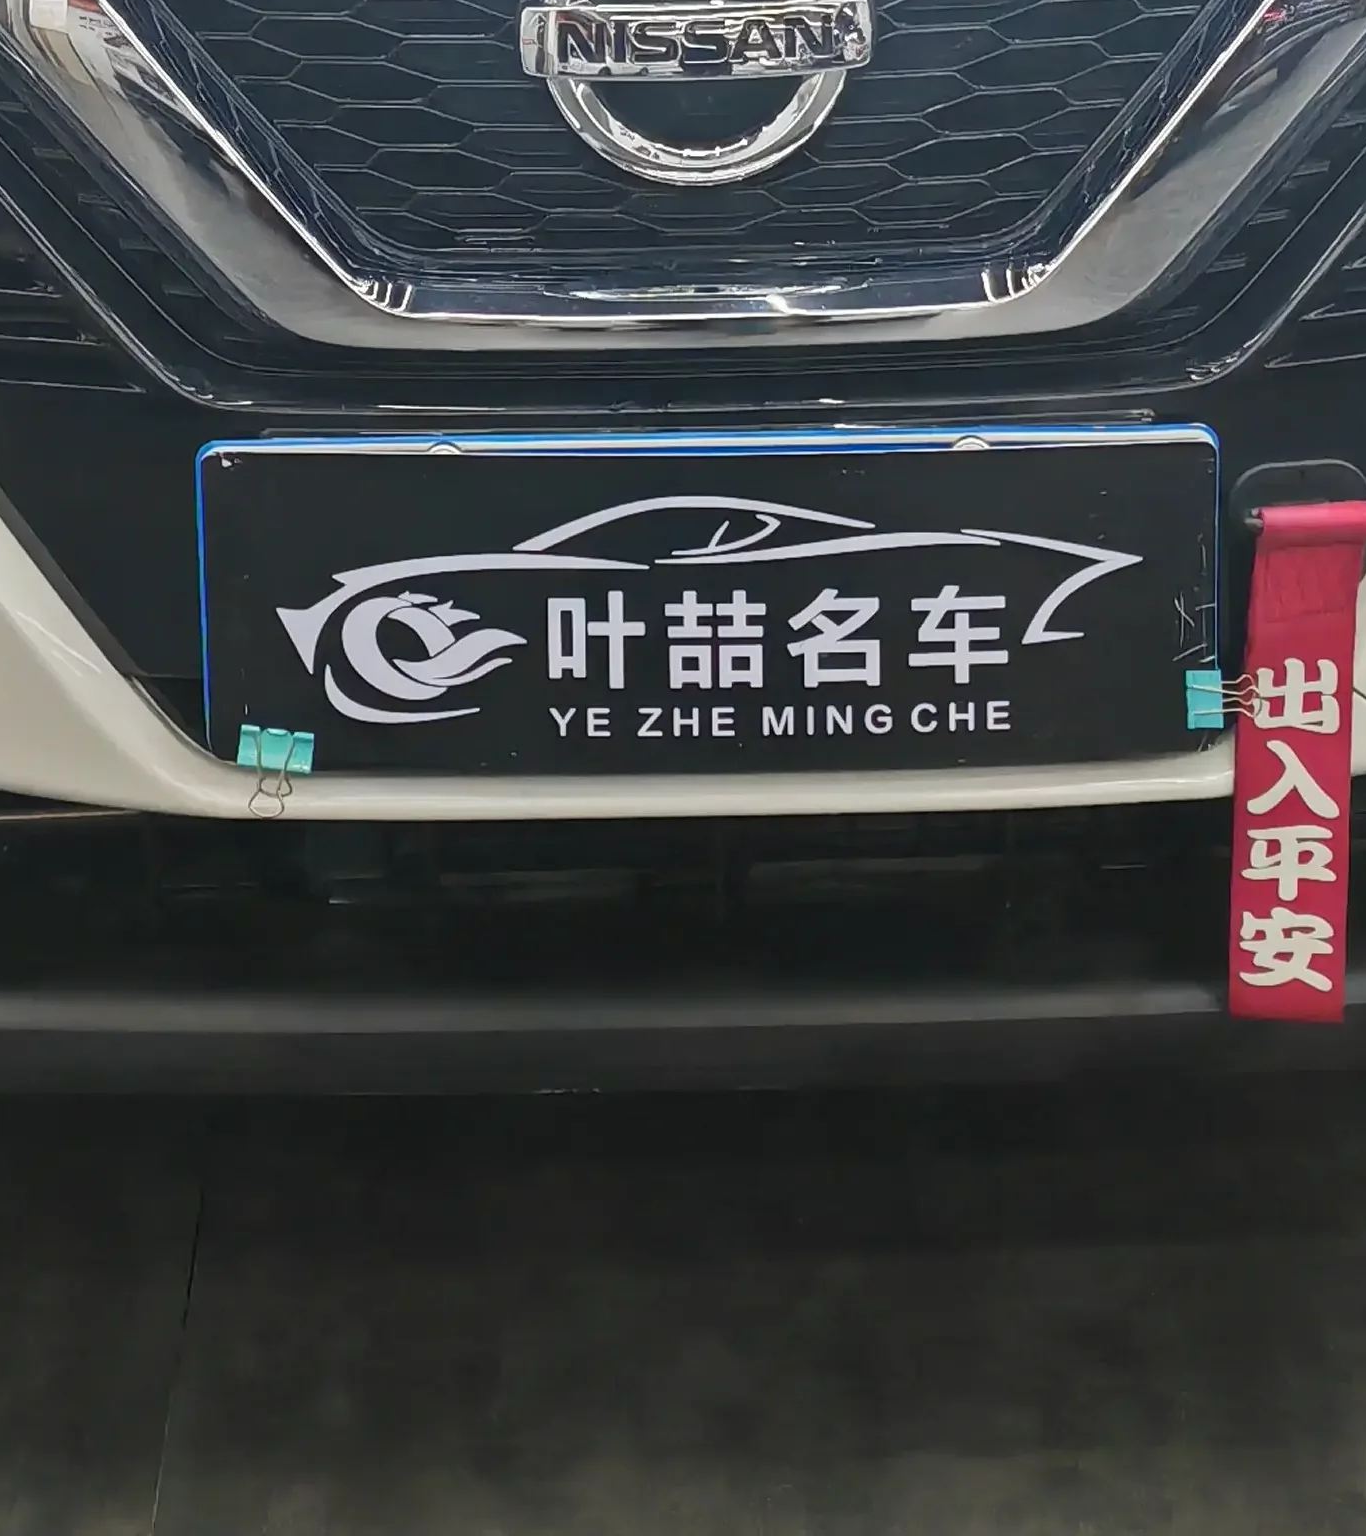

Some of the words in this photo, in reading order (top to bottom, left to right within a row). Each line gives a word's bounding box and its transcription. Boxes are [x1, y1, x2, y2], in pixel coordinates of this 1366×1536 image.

[555, 15, 834, 66] NISSAN
[546, 584, 1010, 690] 叶喆名车
[549, 706, 612, 738] YE
[636, 706, 736, 738] ZHE
[761, 703, 894, 737] MING
[910, 699, 1012, 733] CHE
[1238, 657, 1341, 993] 出入平安
